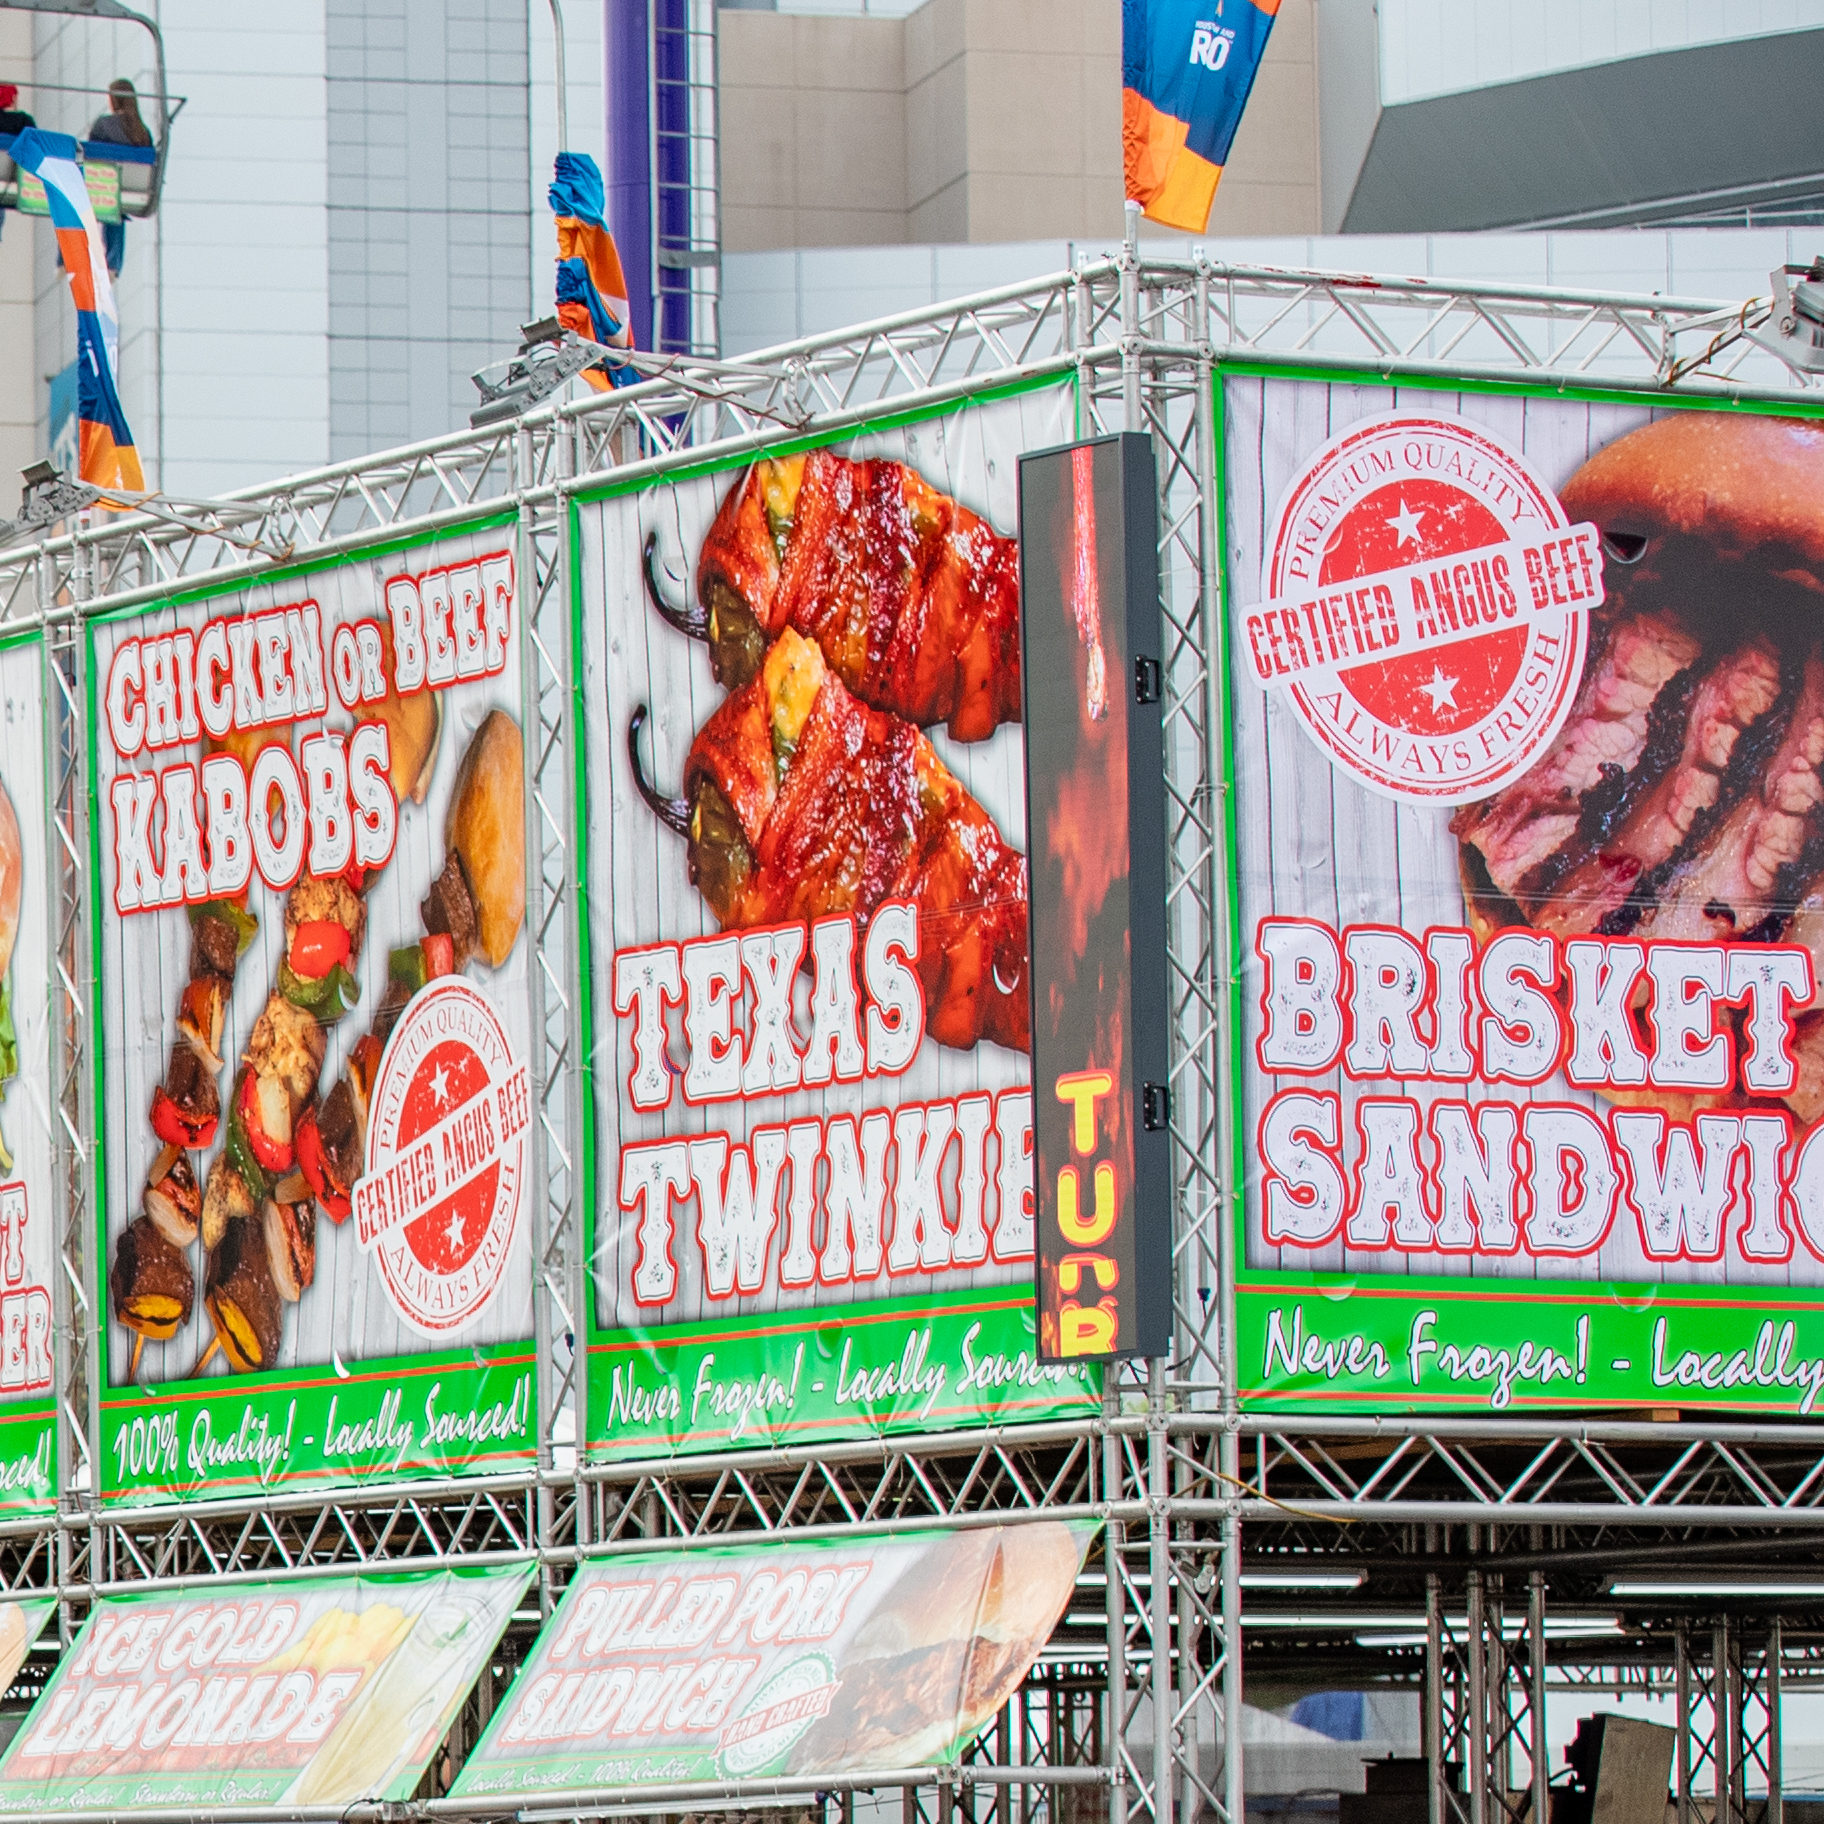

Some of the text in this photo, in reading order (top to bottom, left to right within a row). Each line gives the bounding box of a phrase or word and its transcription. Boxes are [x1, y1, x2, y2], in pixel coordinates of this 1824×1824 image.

[1288, 441, 1535, 582] PREMIUM QUALITY
[106, 549, 514, 759] CHICKEN OR BEEF
[1246, 534, 1596, 680] CERTIFIED ANGUS BEEF
[1316, 632, 1560, 774] ALWAYS FRESH
[110, 720, 398, 916] KABOBS
[614, 894, 925, 1113] TEXAS
[1256, 915, 1813, 1096] BRISKET
[380, 1005, 503, 1150] PREMIUM QUALITY
[357, 1064, 531, 1245] CERTIFIED ANGUS BEEF
[390, 1163, 516, 1311] ALWAYS FRESH
[607, 1326, 947, 1443] Never Frozen! Locally
[1264, 1306, 1390, 1381] Never
[1409, 1309, 1589, 1410] Frozen!
[112, 1371, 532, 1487] 100% Quality! Locally Sourced!
[69, 1598, 300, 1681] ICE COLD
[547, 1560, 874, 1662] PULLED PORK
[21, 1666, 366, 1758] LEMONADE
[497, 1652, 762, 1748] SANDWICH
[726, 1694, 830, 1745] HAND CRAFTED
[465, 1770, 518, 1794] Locally
